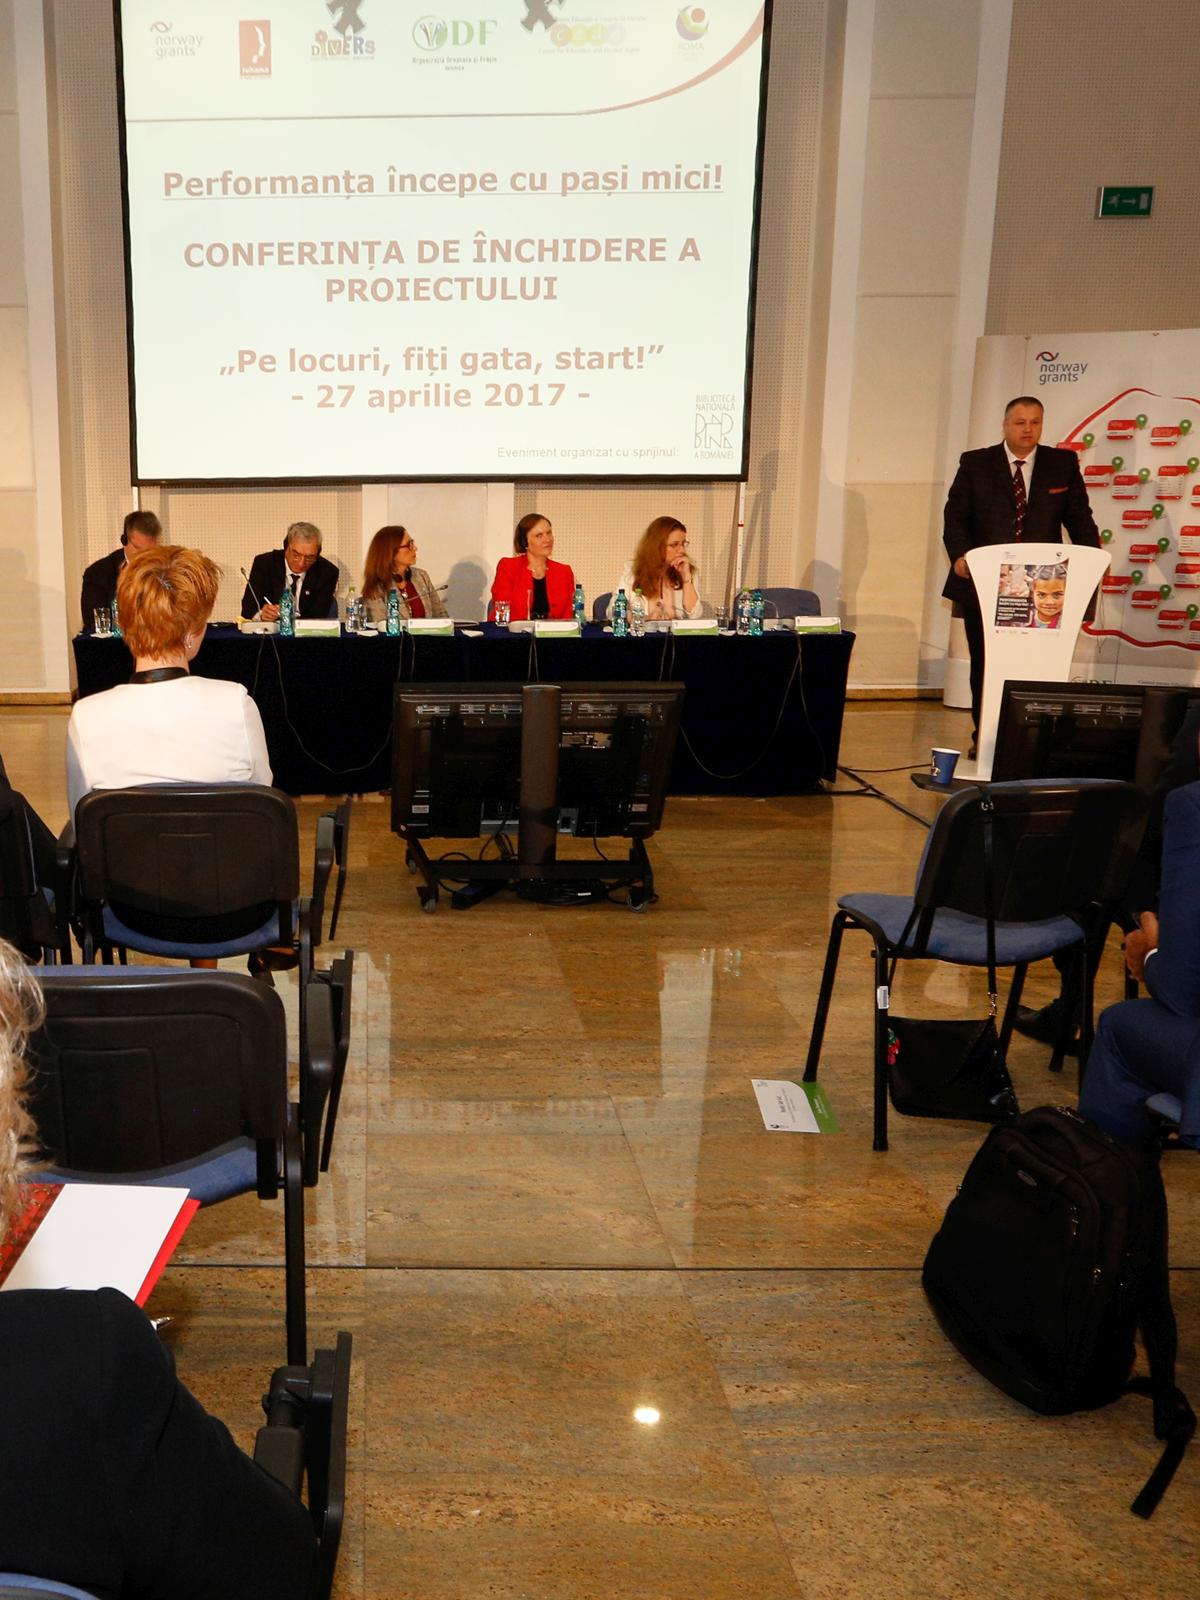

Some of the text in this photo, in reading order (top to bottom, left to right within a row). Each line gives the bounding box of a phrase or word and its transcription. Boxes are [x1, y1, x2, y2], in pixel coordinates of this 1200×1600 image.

[156, 34, 203, 48] norway
[155, 45, 196, 60] grants
[163, 163, 723, 199] Performanța începe cu pași mici!
[184, 230, 702, 271] CONFERINȚA DE ÎNCHIDERE A
[325, 276, 558, 303] PROIECTULUI
[289, 347, 391, 377] locuri,
[403, 346, 448, 377] fiți
[460, 347, 543, 377] gata,
[1040, 363, 1088, 374] norway
[1039, 372, 1079, 385] grants
[316, 384, 356, 408] 27
[368, 382, 472, 413] aprilie
[484, 382, 566, 407] 2017
[497, 447, 680, 460] Eveniment organizat cu sprijinul:
